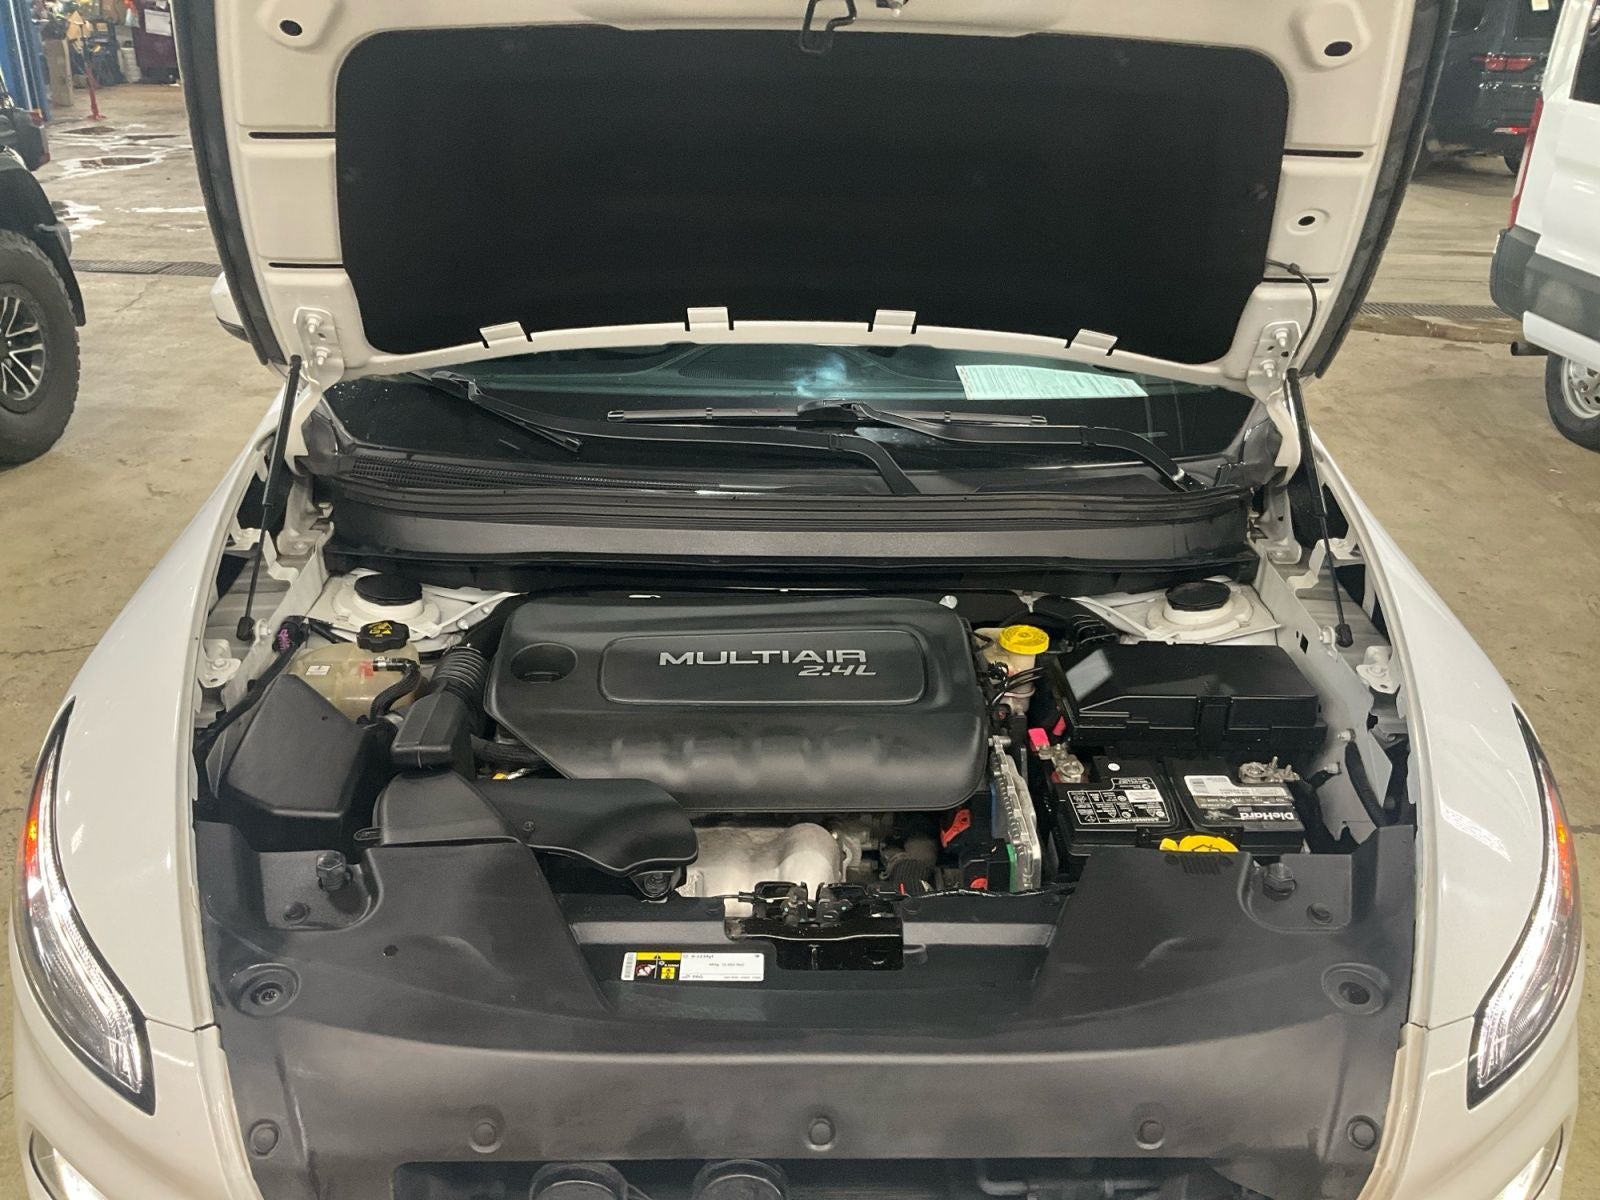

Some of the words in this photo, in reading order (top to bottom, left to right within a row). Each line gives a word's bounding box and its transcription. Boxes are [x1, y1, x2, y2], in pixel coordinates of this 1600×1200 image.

[658, 649, 868, 666] MULTIAIR
[797, 664, 877, 677] 2.4L
[1239, 811, 1295, 821] DieHard
